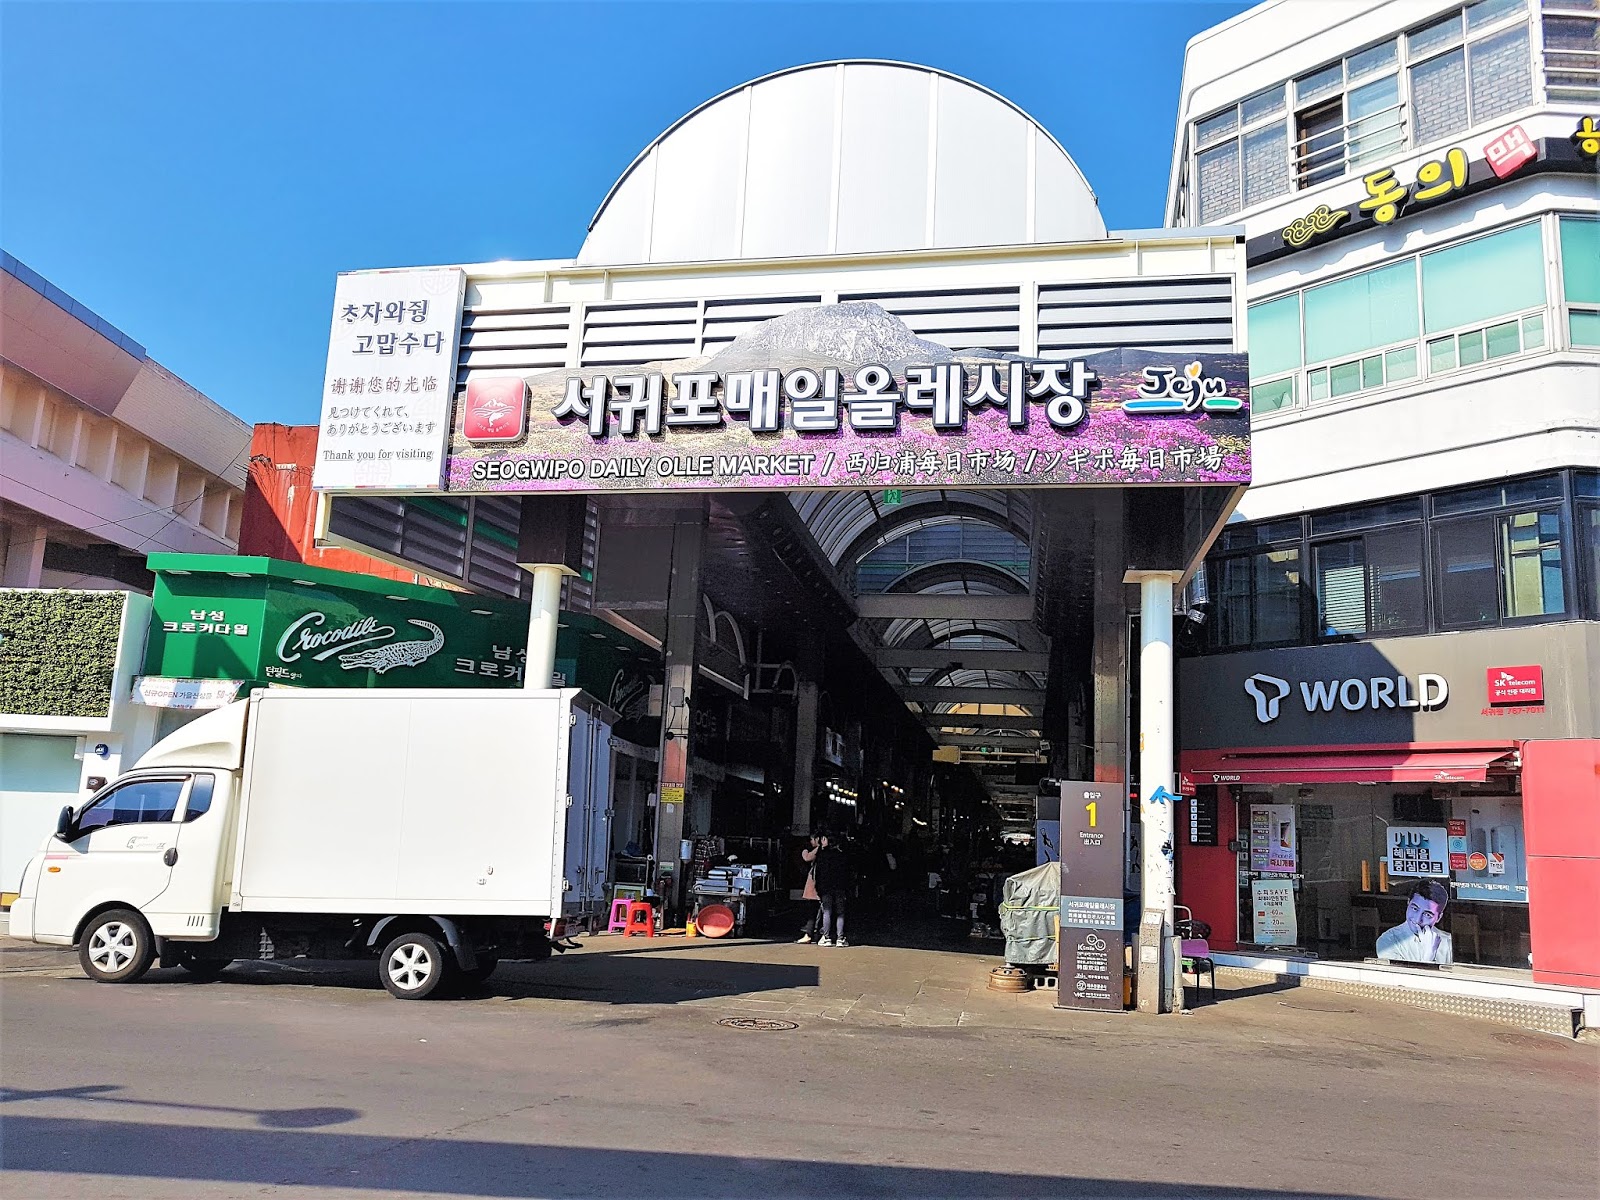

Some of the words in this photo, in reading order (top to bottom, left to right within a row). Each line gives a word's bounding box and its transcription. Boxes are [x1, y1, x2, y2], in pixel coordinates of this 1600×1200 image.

[1358, 147, 1468, 225] 동의
[1488, 131, 1533, 170] 맥
[351, 330, 445, 356] 고맙수다
[331, 376, 438, 395] 谢谢您的光临
[1139, 361, 1229, 411] Jeju
[551, 358, 1098, 438] 서귀포매일올레시장
[326, 421, 436, 436] ありがとうございます
[322, 449, 355, 461] Thank
[356, 451, 376, 462] you
[377, 448, 394, 460] for
[396, 447, 434, 462] visiting
[845, 448, 1018, 476] 西归浦每日市场
[472, 458, 585, 480] SEOGWIPO
[589, 457, 651, 479] DAILY
[656, 455, 715, 478] OLLE
[718, 453, 816, 477] MARKET
[190, 609, 225, 622] 남성
[162, 621, 249, 637] 크로커다일
[275, 610, 390, 664] Crocodile
[454, 657, 567, 688] 크로커일
[1494, 679, 1506, 687] SK
[1300, 672, 1450, 712] WORLD
[1085, 801, 1097, 827] 1
[1079, 831, 1104, 839] Entrance
[1083, 838, 1102, 846] 出入口
[1392, 847, 1430, 861] 혜택을
[1392, 860, 1444, 873] 중심으로
